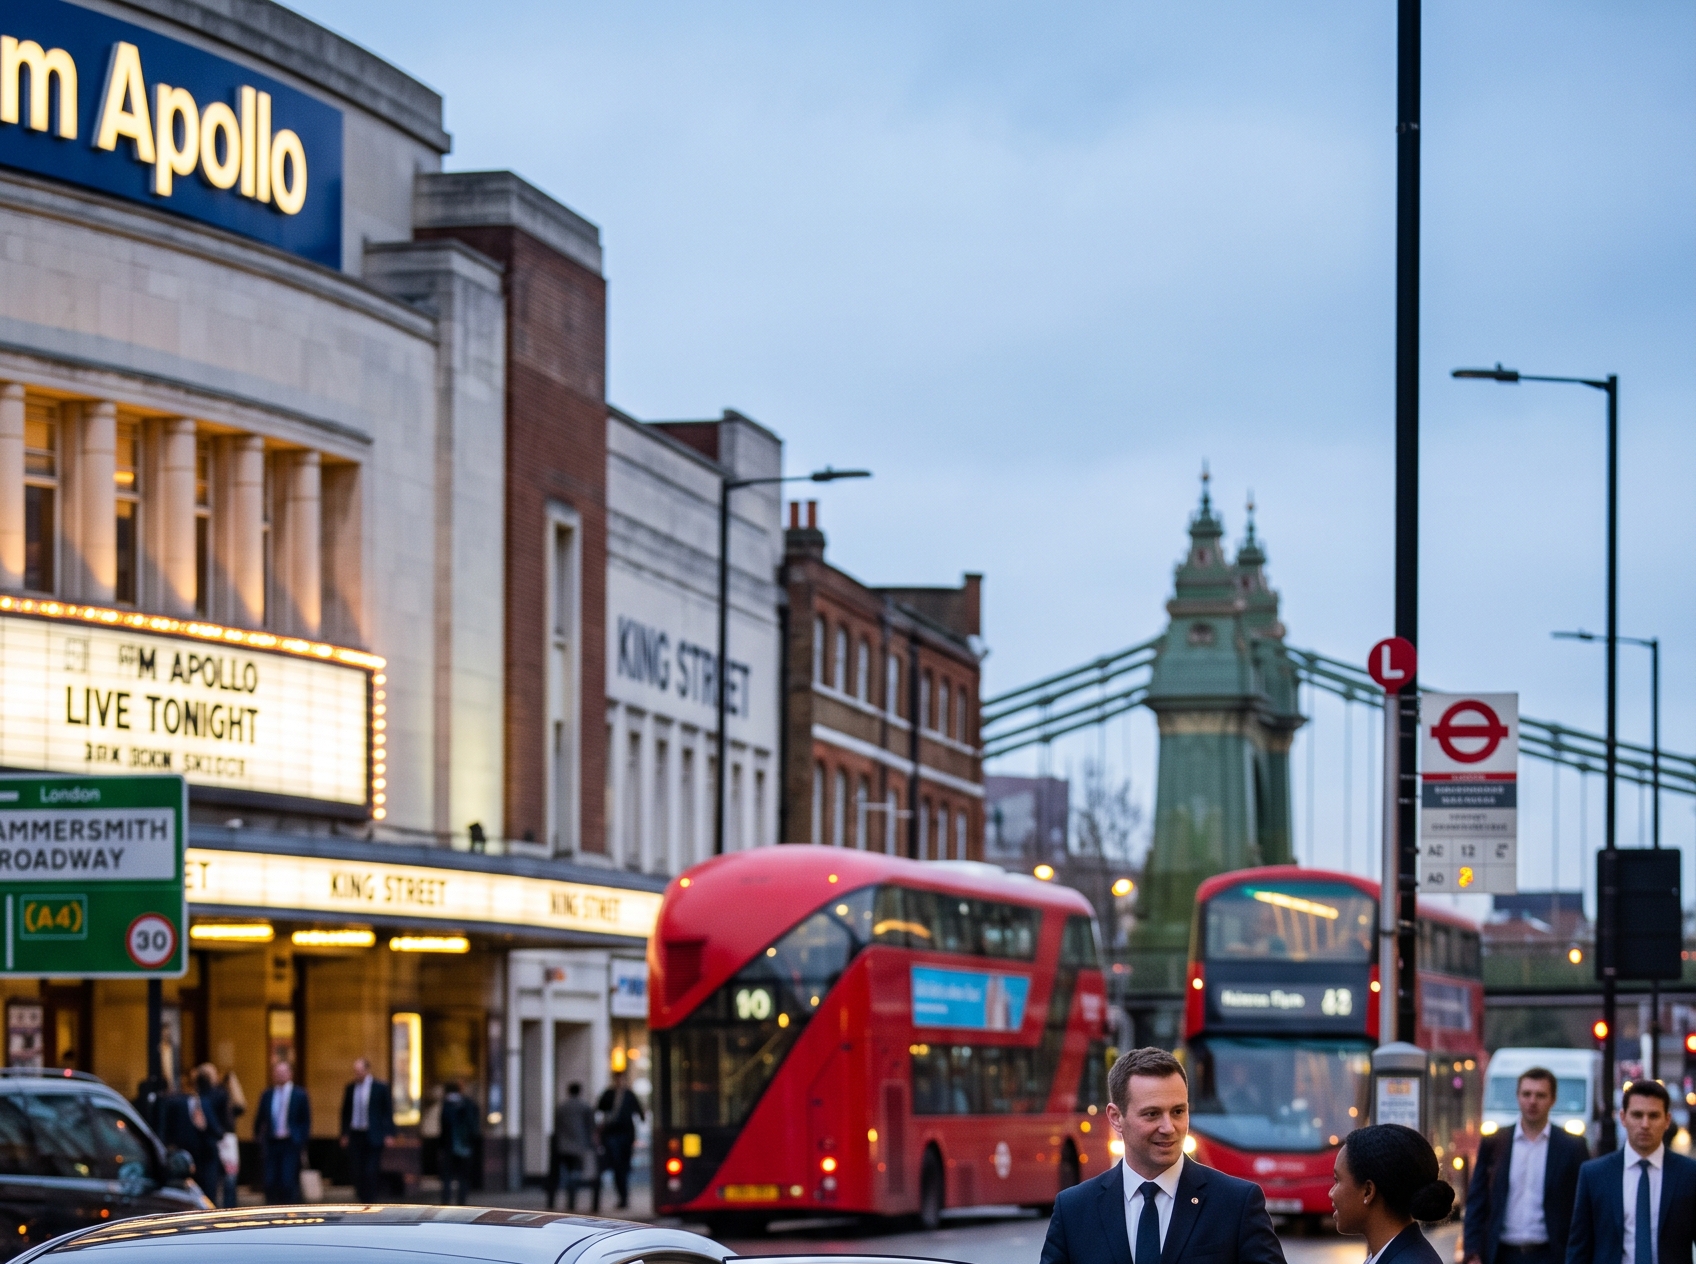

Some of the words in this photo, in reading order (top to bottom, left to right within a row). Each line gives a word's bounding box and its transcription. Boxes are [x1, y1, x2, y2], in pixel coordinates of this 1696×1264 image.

[92, 41, 307, 215] Apollo
[171, 652, 258, 694] APOLLO
[677, 638, 751, 720] STRET
[1381, 645, 1404, 679] L
[67, 686, 131, 730] LIVE
[146, 695, 258, 744] TONIGHT
[40, 786, 101, 803] London
[384, 875, 446, 906] STREET
[24, 901, 84, 934] (A4)
[136, 930, 168, 951] 30
